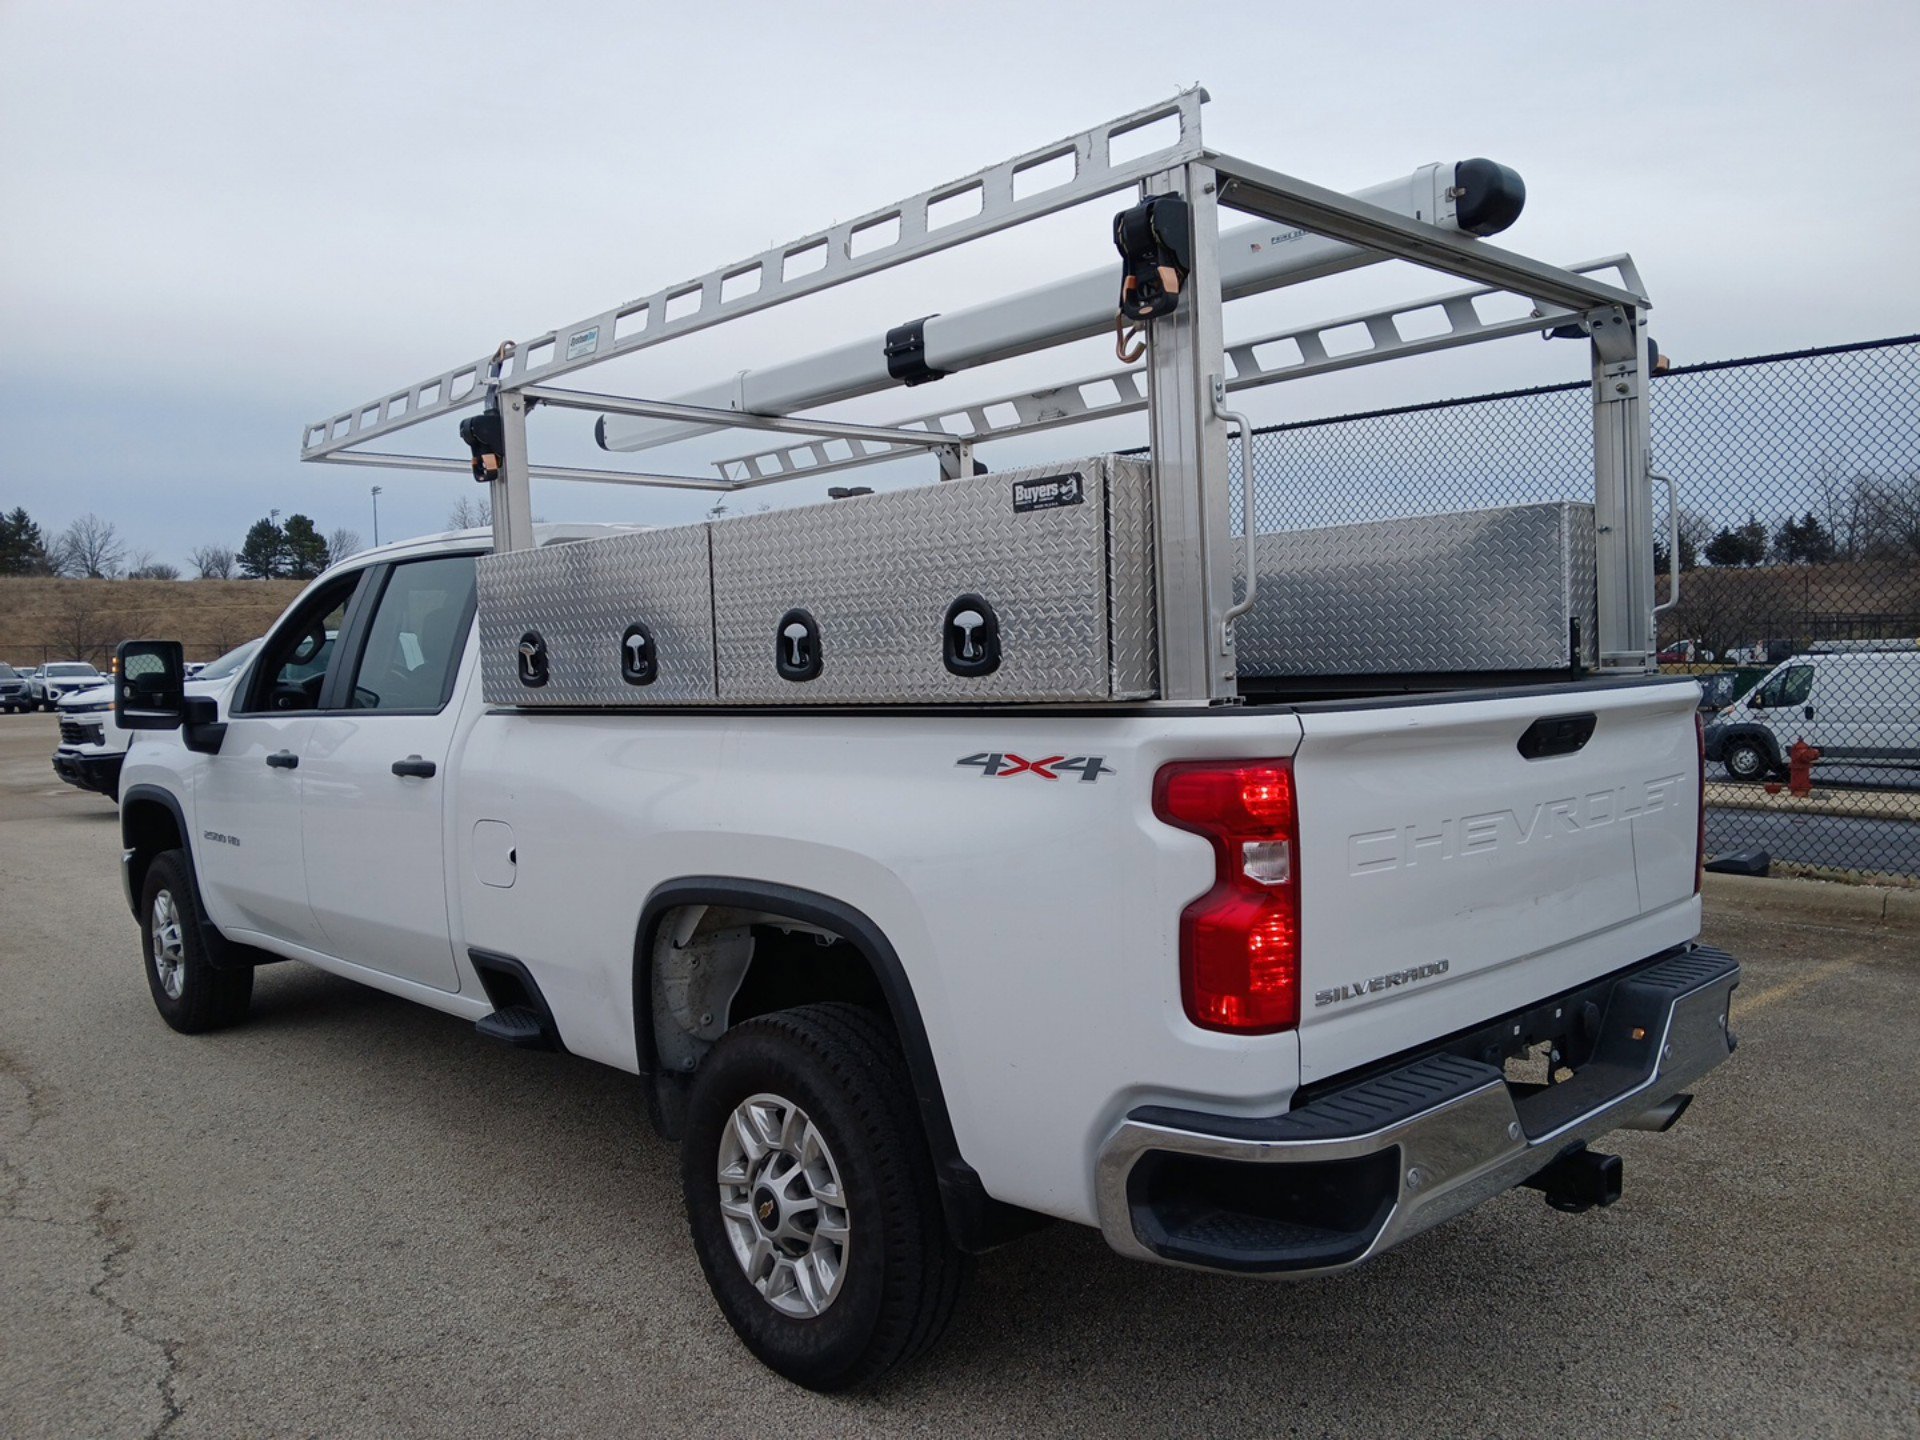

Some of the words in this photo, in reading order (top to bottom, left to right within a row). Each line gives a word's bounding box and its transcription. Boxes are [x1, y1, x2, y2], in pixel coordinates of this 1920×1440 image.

[1015, 483, 1058, 502] Buyers
[1348, 772, 1686, 876] CHEVROLET
[1315, 959, 1449, 1007] SILVERADO
